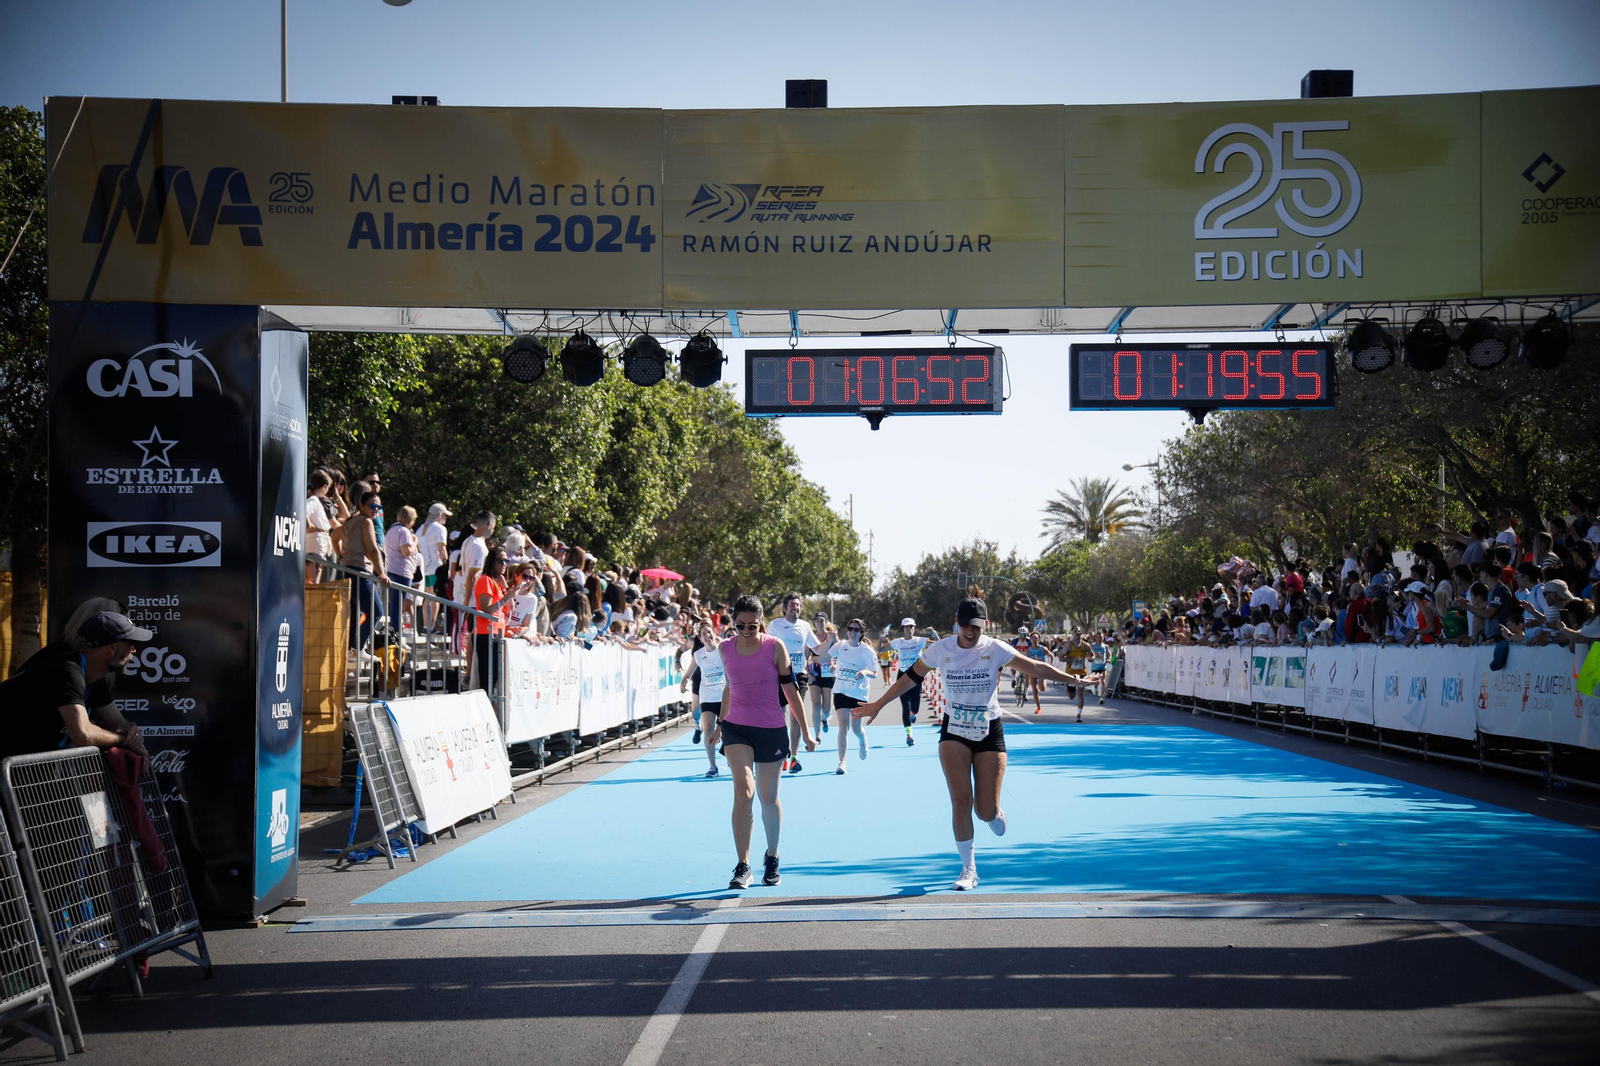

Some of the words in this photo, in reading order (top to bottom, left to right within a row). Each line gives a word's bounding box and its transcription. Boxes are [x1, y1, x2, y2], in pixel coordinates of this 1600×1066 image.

[268, 171, 314, 203] 25
[1194, 120, 1362, 239] 25
[349, 173, 470, 204] Medio
[490, 176, 656, 207] Maratón
[761, 185, 825, 198] RFEA
[268, 203, 314, 215] EDICIÓN
[755, 201, 818, 212] SERIES
[750, 213, 790, 223] RUTA
[793, 213, 854, 223] RUNNING
[1521, 211, 1559, 225] 2005
[347, 211, 523, 252] Almería
[534, 214, 656, 253] 2024
[682, 230, 779, 253] RAMÓN
[792, 234, 854, 253] RUIZ
[864, 229, 992, 253] ANDÚJAR
[1194, 242, 1364, 281] EDICIÓN
[86, 358, 194, 398] CASI
[786, 355, 990, 406] 01:06:52
[1112, 350, 1322, 400] 01:19:55
[86, 467, 224, 485] ESTRELLA
[117, 485, 136, 494] DE
[136, 485, 193, 494] LEVANTE
[105, 535, 207, 554] IKEA
[127, 594, 180, 607] Barceló
[128, 608, 161, 621] Cabo
[164, 608, 181, 621] de
[123, 646, 187, 684] ego
[162, 676, 176, 684] sport
[1493, 670, 1522, 692] ALMERÍA
[1534, 671, 1572, 696] ALMERÍA
[173, 697, 196, 713] 40
[954, 709, 985, 722] 5174
[143, 727, 155, 736] de
[156, 727, 194, 736] Almería
